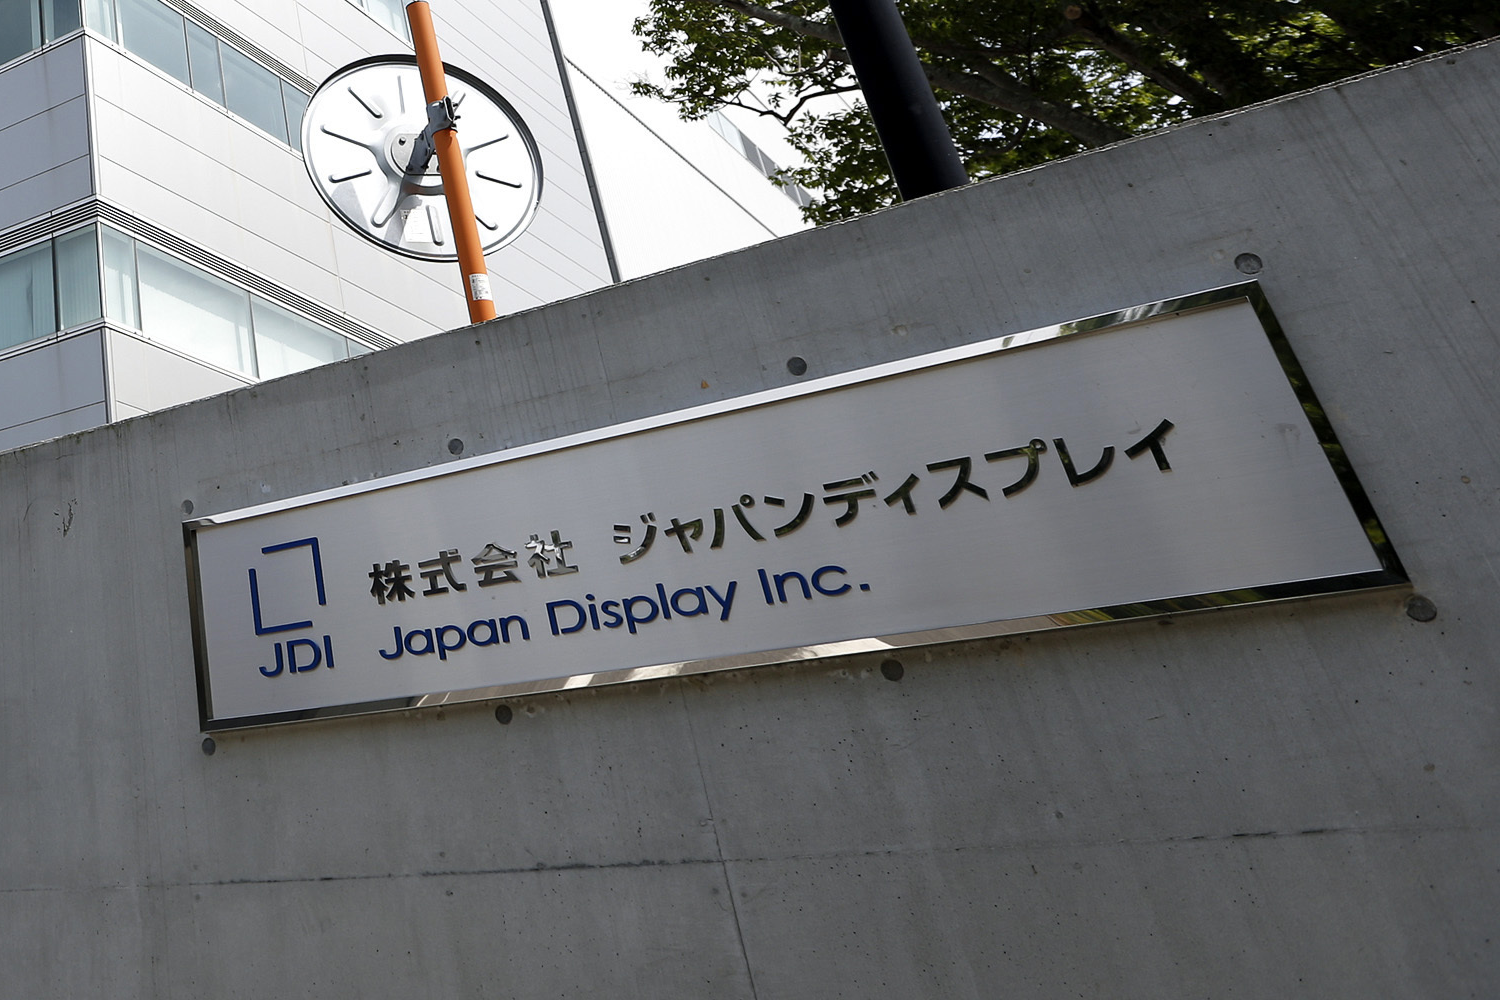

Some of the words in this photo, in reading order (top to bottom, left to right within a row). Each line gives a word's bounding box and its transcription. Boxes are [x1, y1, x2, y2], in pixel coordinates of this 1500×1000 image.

[368, 531, 578, 604] 株式会社
[612, 419, 1175, 564] ジャパンディスプレイ
[258, 635, 335, 678] JDI
[379, 615, 530, 660] Japan
[546, 580, 737, 636] Display
[757, 565, 871, 606] Inc.
